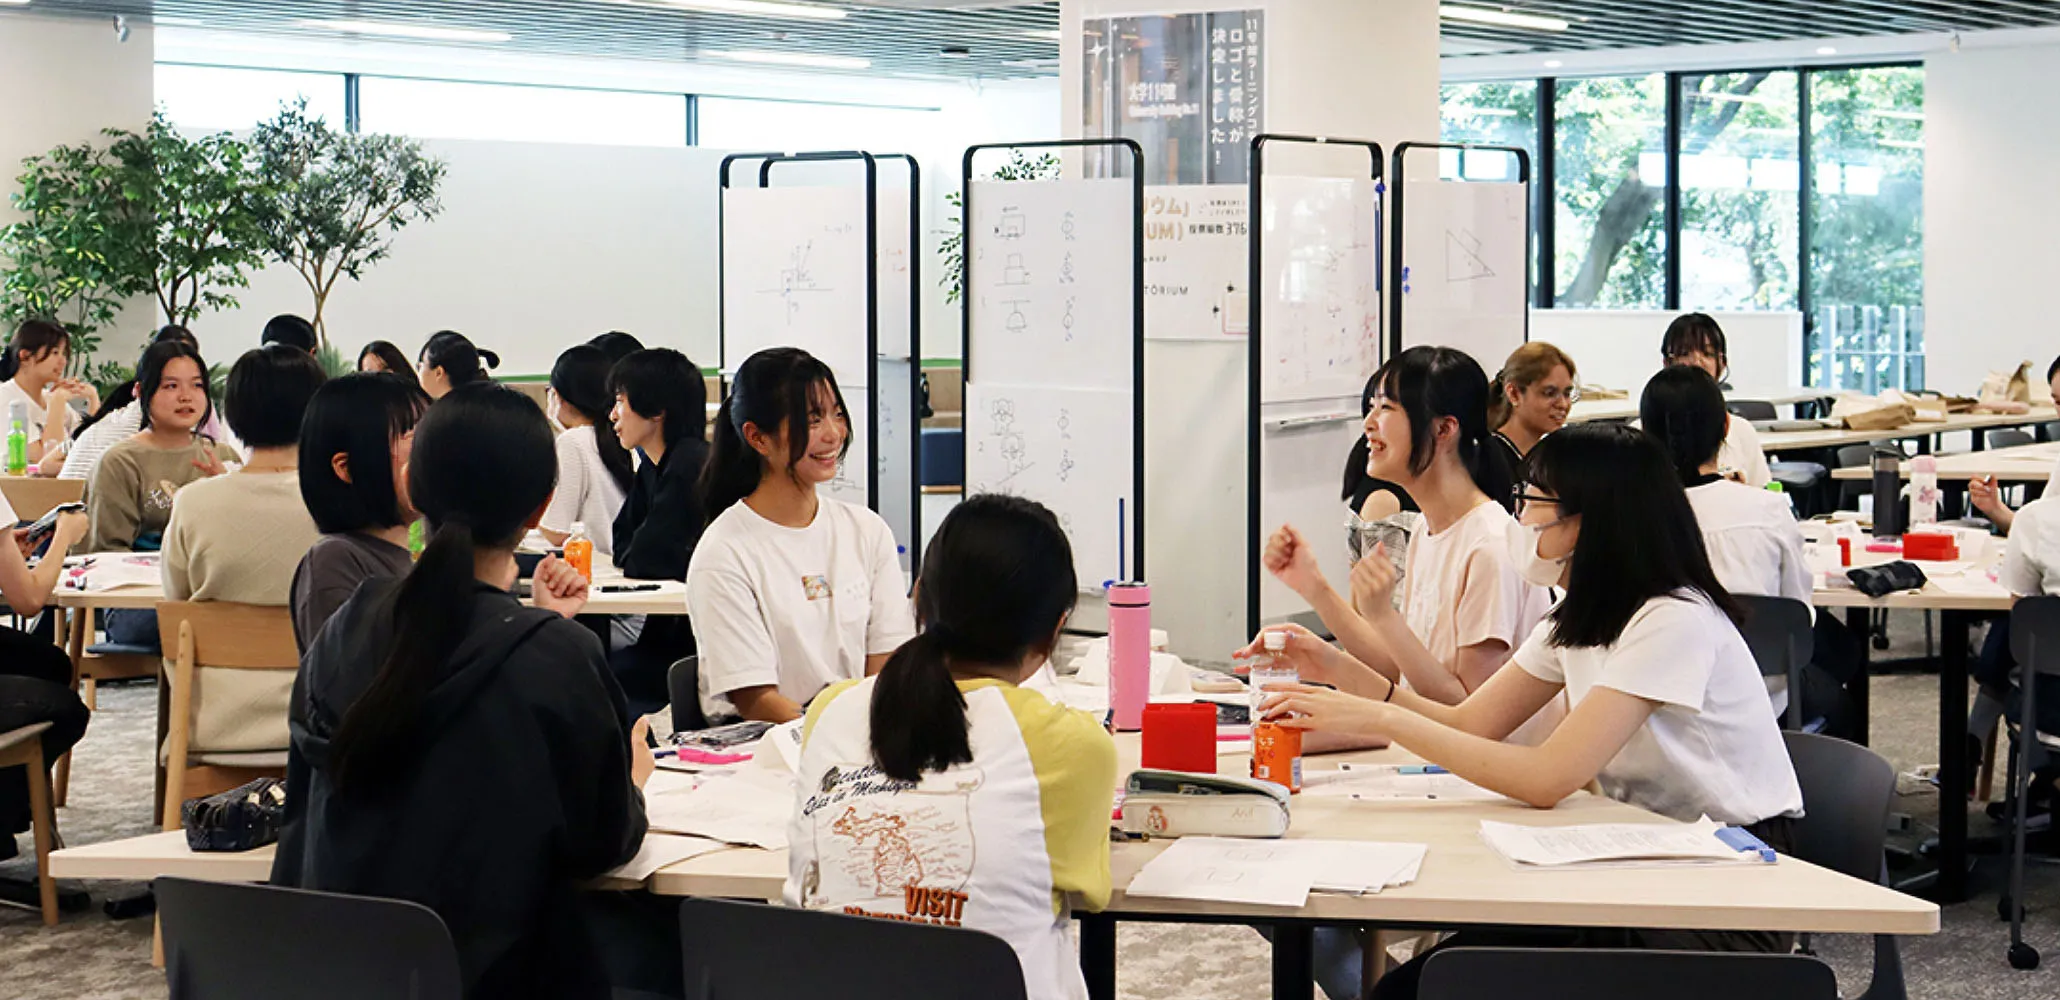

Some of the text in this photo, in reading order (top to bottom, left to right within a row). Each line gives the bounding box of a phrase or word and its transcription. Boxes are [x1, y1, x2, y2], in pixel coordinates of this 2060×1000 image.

[1229, 28, 1245, 144] ロゴと愛称が
[905, 885, 968, 921] VISIT
